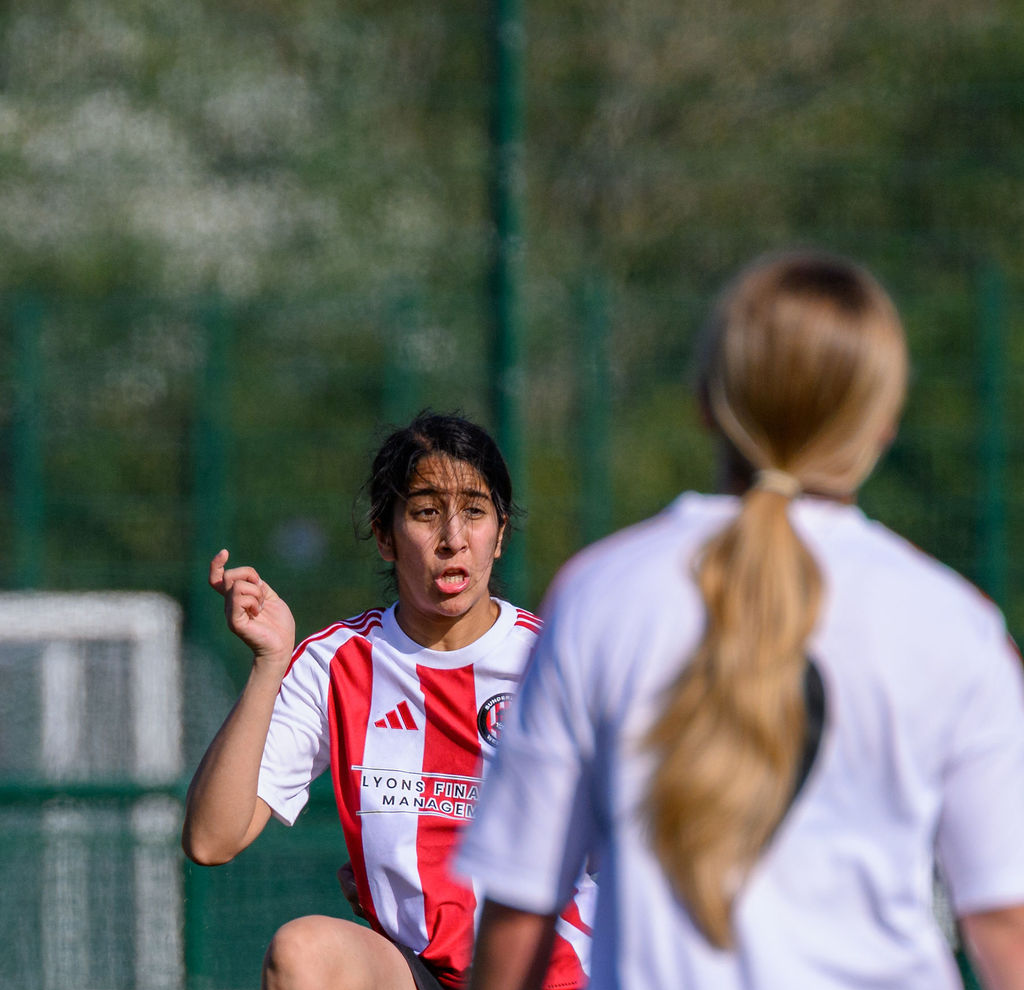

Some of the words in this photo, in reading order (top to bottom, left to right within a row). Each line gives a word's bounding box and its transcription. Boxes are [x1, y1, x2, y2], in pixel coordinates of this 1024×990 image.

[362, 775, 425, 793] LYONS
[434, 781, 480, 800] FINA
[382, 795, 477, 818] MANAGEM
